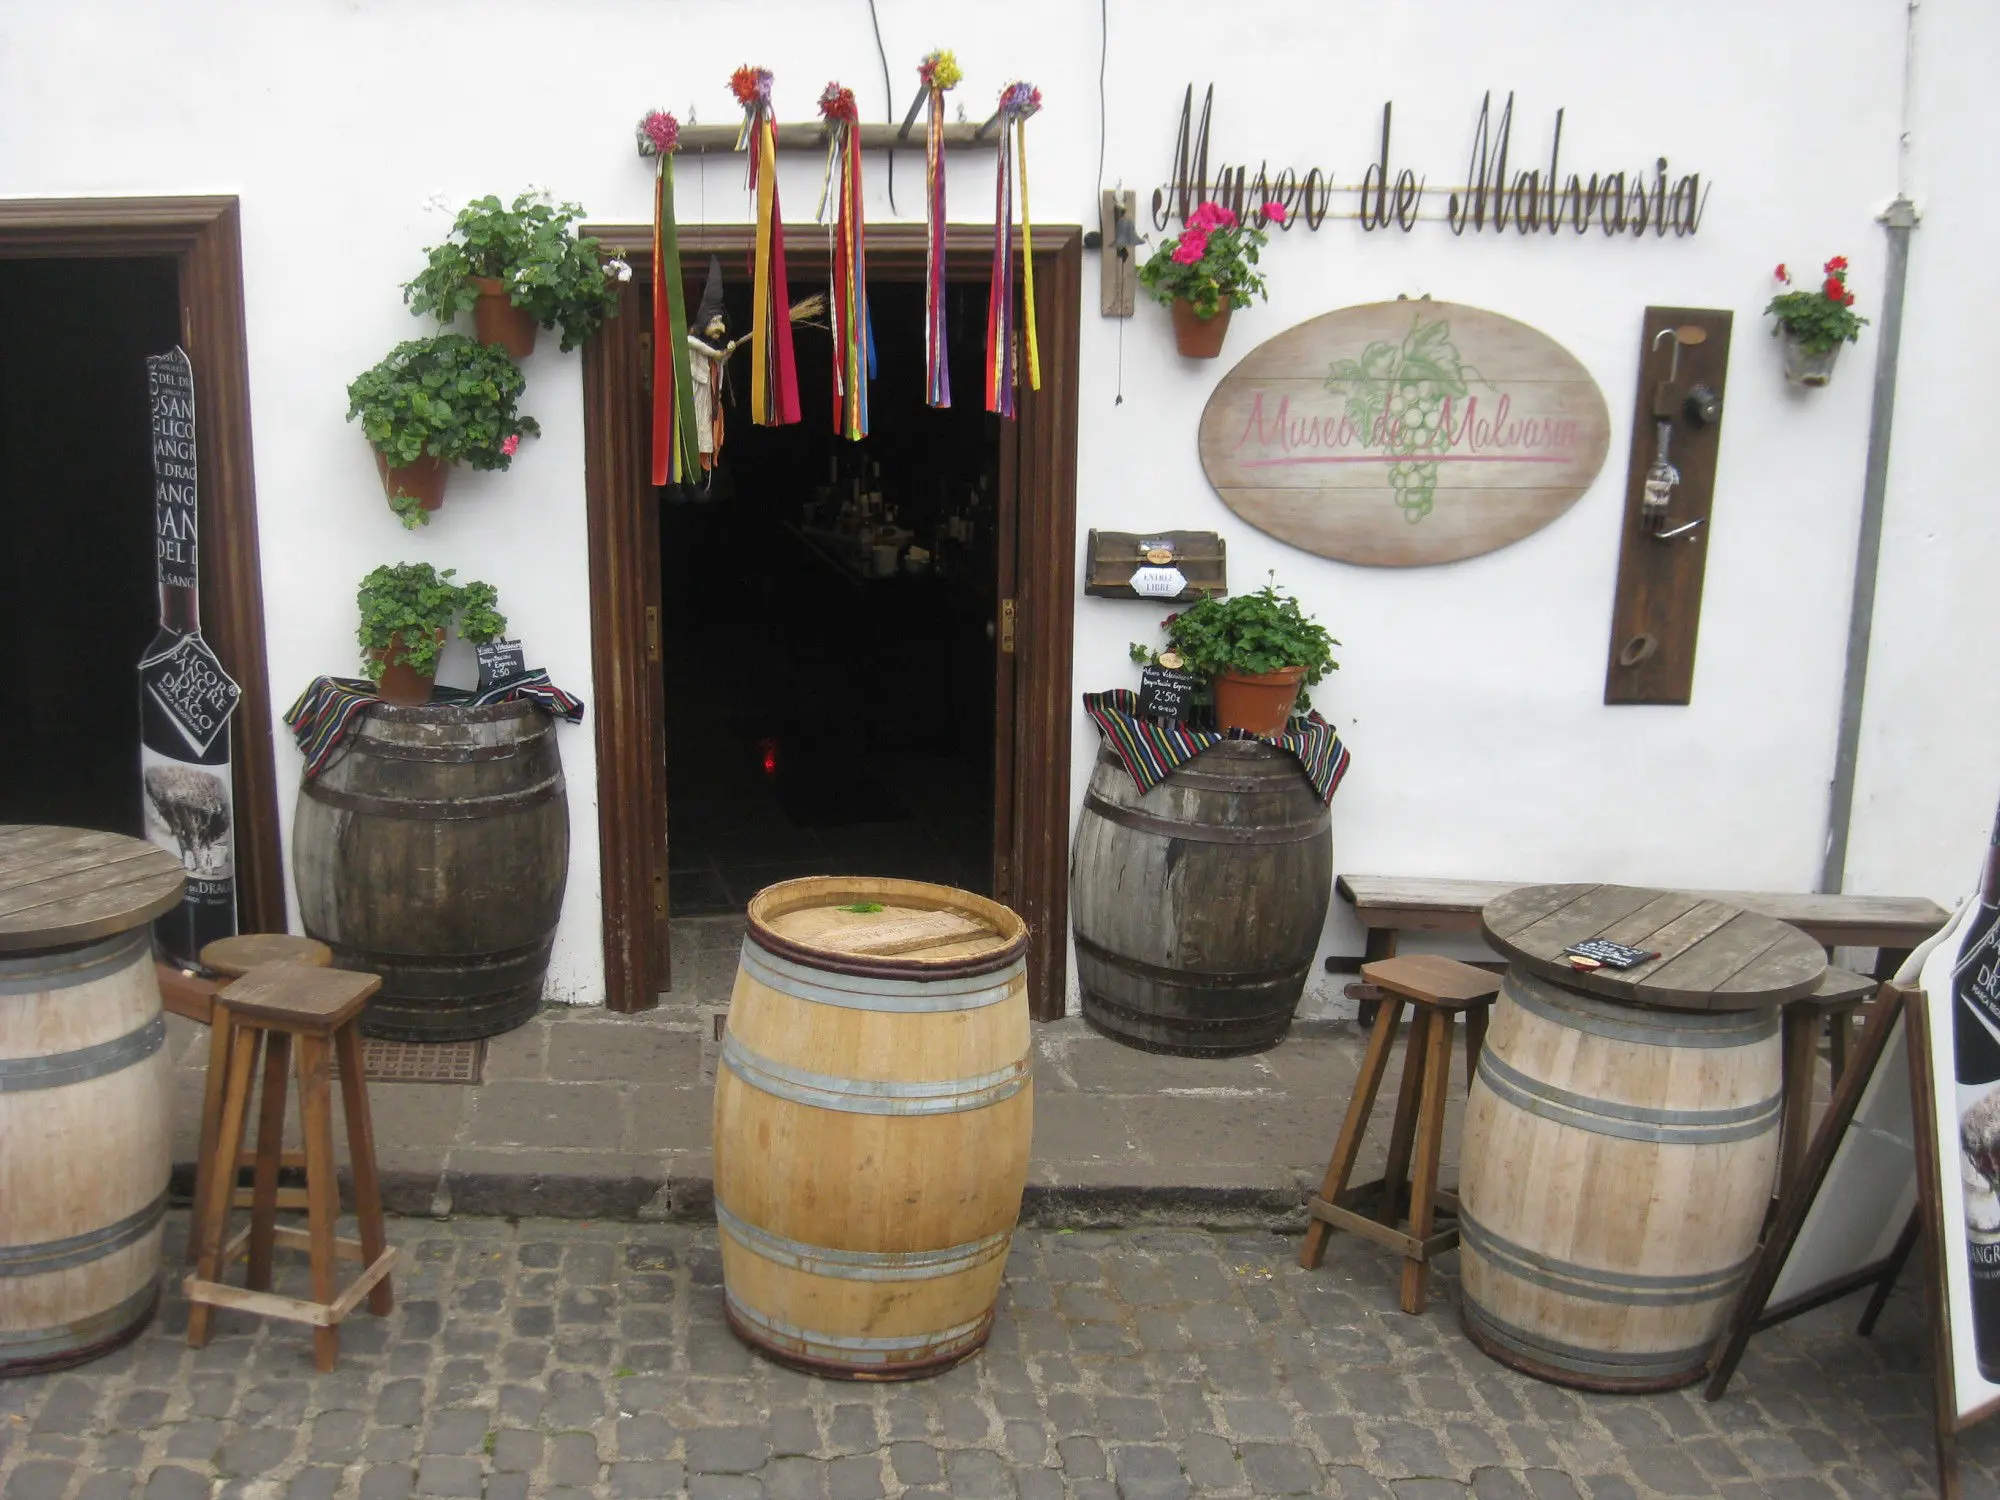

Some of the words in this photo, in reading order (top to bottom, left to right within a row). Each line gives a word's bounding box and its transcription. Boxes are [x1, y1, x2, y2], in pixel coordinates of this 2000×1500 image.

[1153, 82, 1334, 232] Museo
[1360, 100, 1425, 232] de
[1449, 90, 1711, 238] Malvasia
[1232, 393, 1358, 452] Museo
[1371, 388, 1410, 448] de
[179, 673, 204, 708] DEL
[183, 646, 226, 697] LICOR
[162, 672, 213, 729] DRAGO
